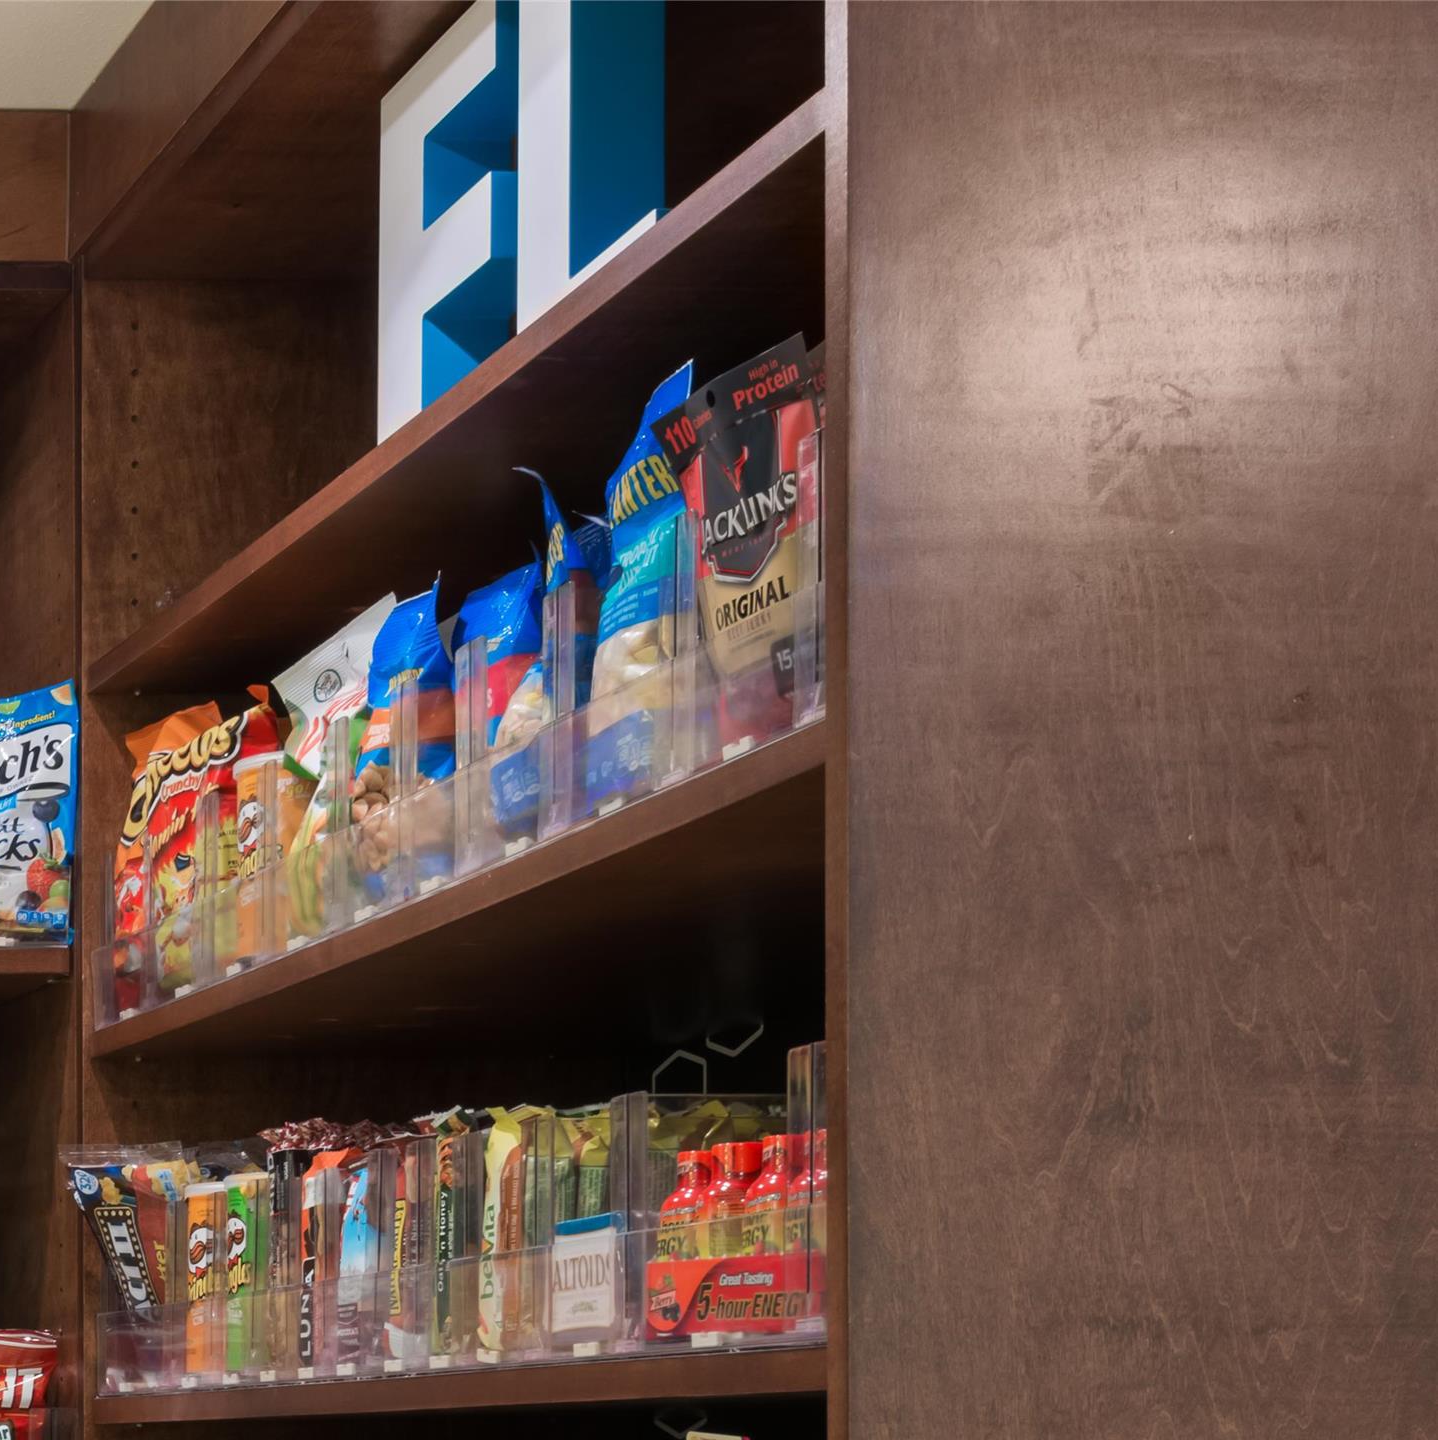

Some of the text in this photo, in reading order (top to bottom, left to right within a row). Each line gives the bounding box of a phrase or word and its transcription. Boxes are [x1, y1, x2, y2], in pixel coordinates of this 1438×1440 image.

[732, 363, 800, 410] Protein
[665, 416, 698, 455] 110
[715, 575, 791, 632] ORIGINAL
[439, 1191, 449, 1240] Honey
[718, 1271, 774, 1287] Great Tasting
[697, 1283, 751, 1321] 5-hour
